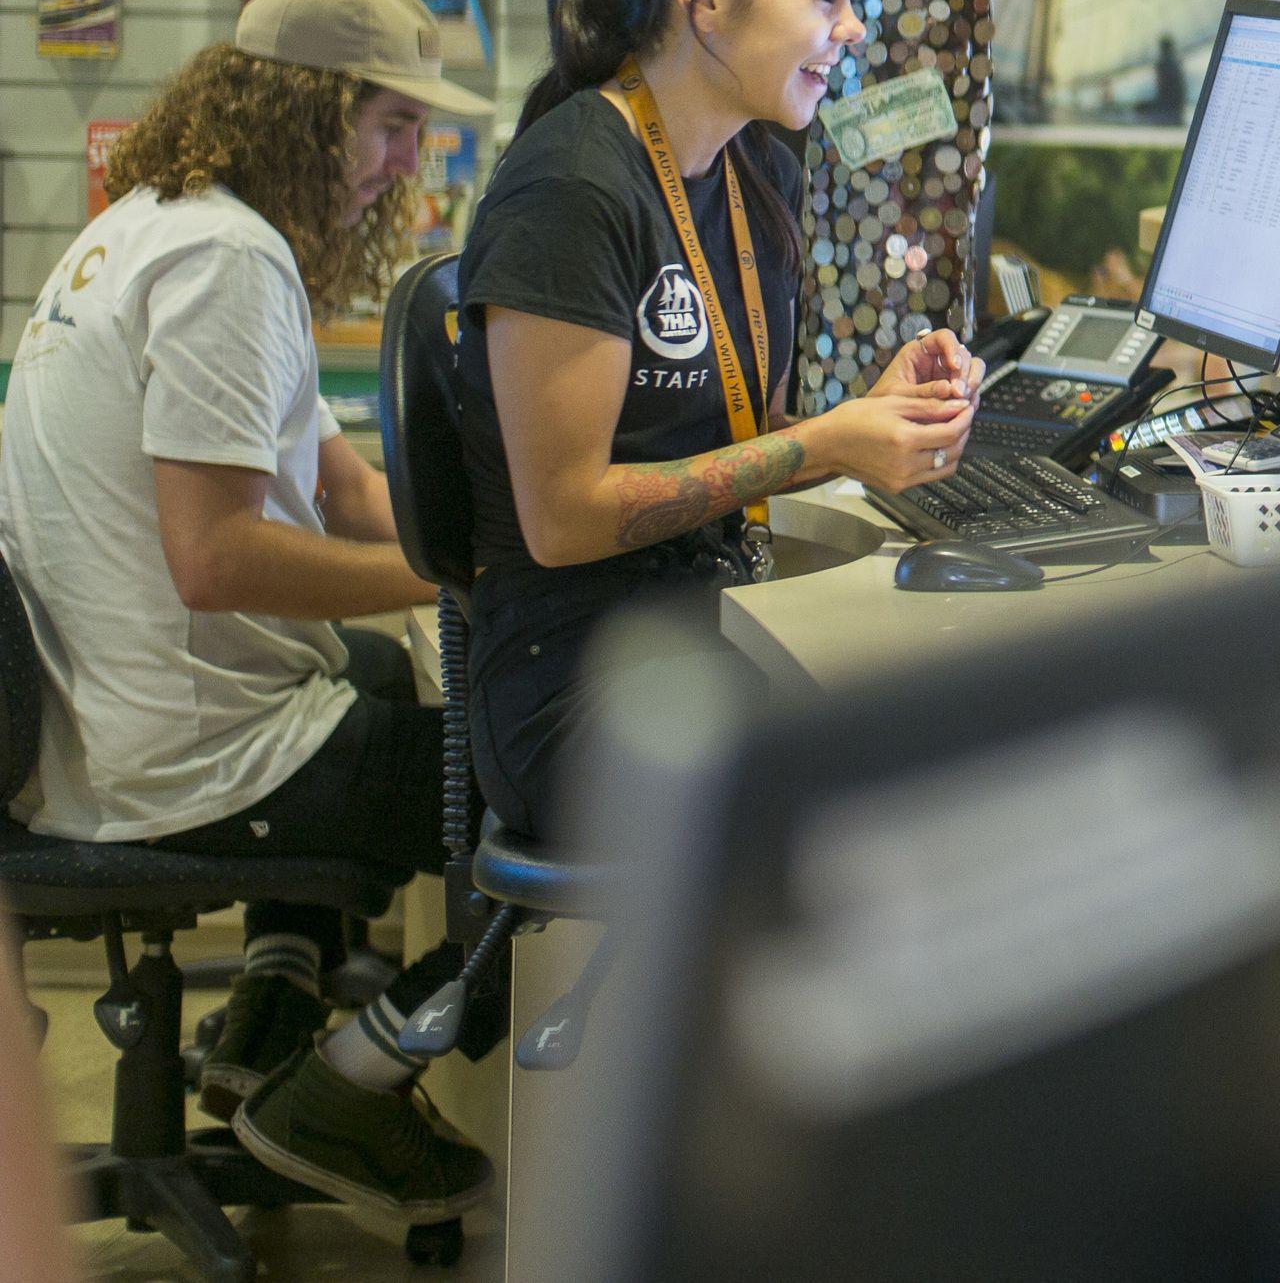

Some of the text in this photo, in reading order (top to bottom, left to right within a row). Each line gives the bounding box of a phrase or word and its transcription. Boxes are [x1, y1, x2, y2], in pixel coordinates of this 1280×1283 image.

[645, 121, 664, 146] SEE
[655, 149, 688, 225] AUSTRALIA
[684, 229, 698, 258] AND
[657, 312, 698, 331] YHA
[720, 343, 738, 380] WITH
[634, 369, 709, 389] STAFF
[728, 383, 745, 414] YHA
